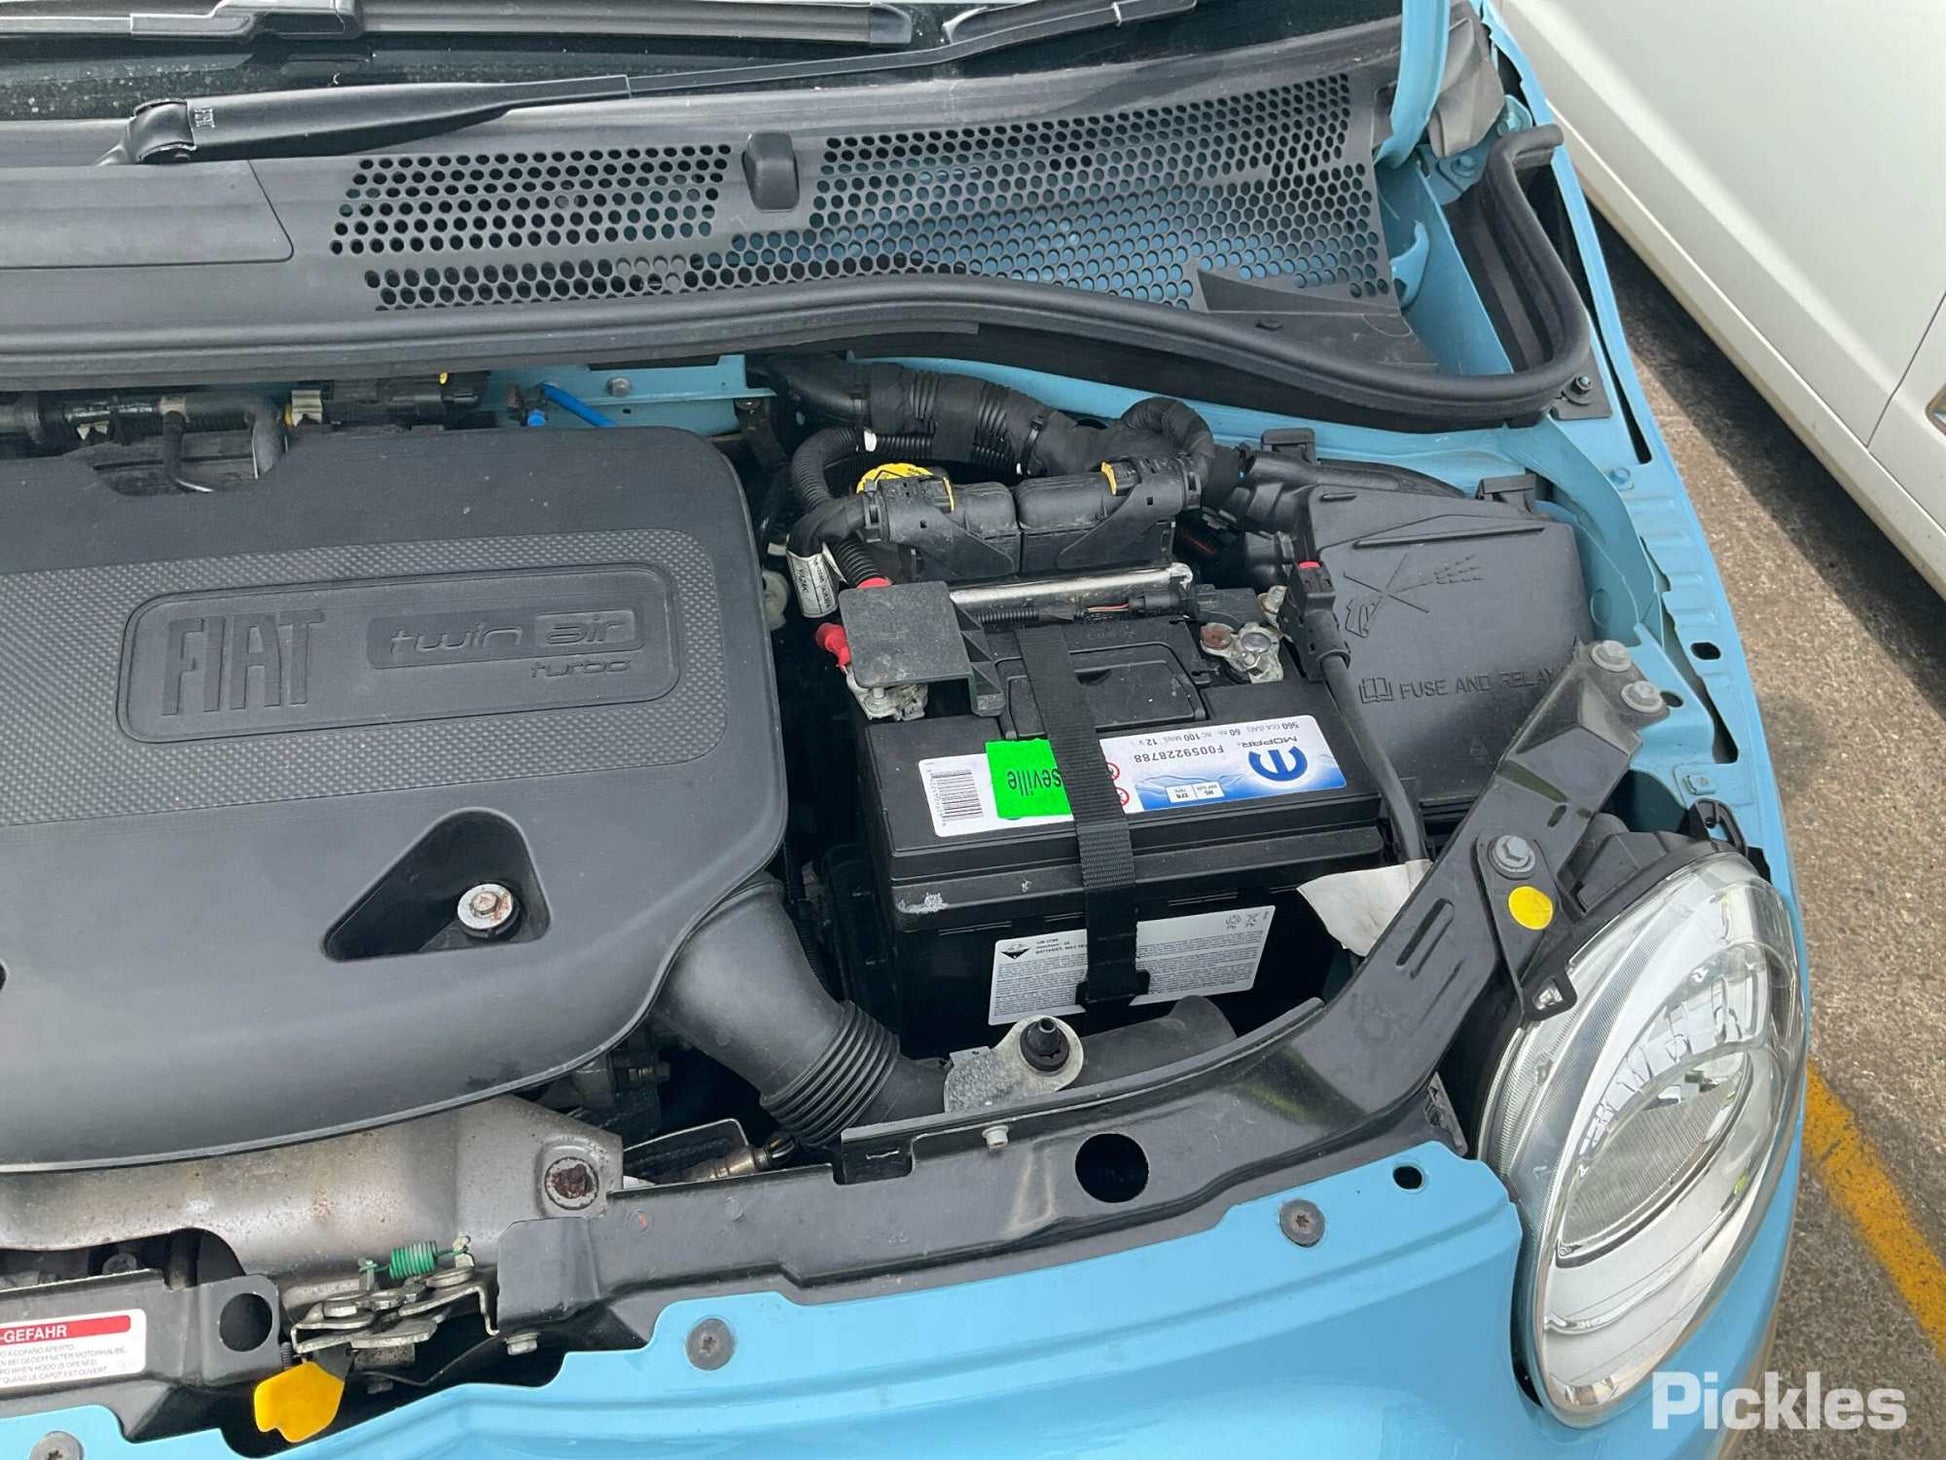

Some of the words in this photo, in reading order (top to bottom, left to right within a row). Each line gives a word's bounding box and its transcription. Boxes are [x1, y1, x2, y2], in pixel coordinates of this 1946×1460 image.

[389, 620, 523, 655] twin
[545, 613, 625, 648] air
[162, 608, 326, 716] FIAT
[530, 657, 632, 679] turbo
[1400, 679, 1449, 699] FUSE
[1456, 674, 1491, 694] AND
[1145, 738, 1158, 746] 12
[1183, 733, 1200, 742] 100
[1133, 744, 1225, 763] F0059228788
